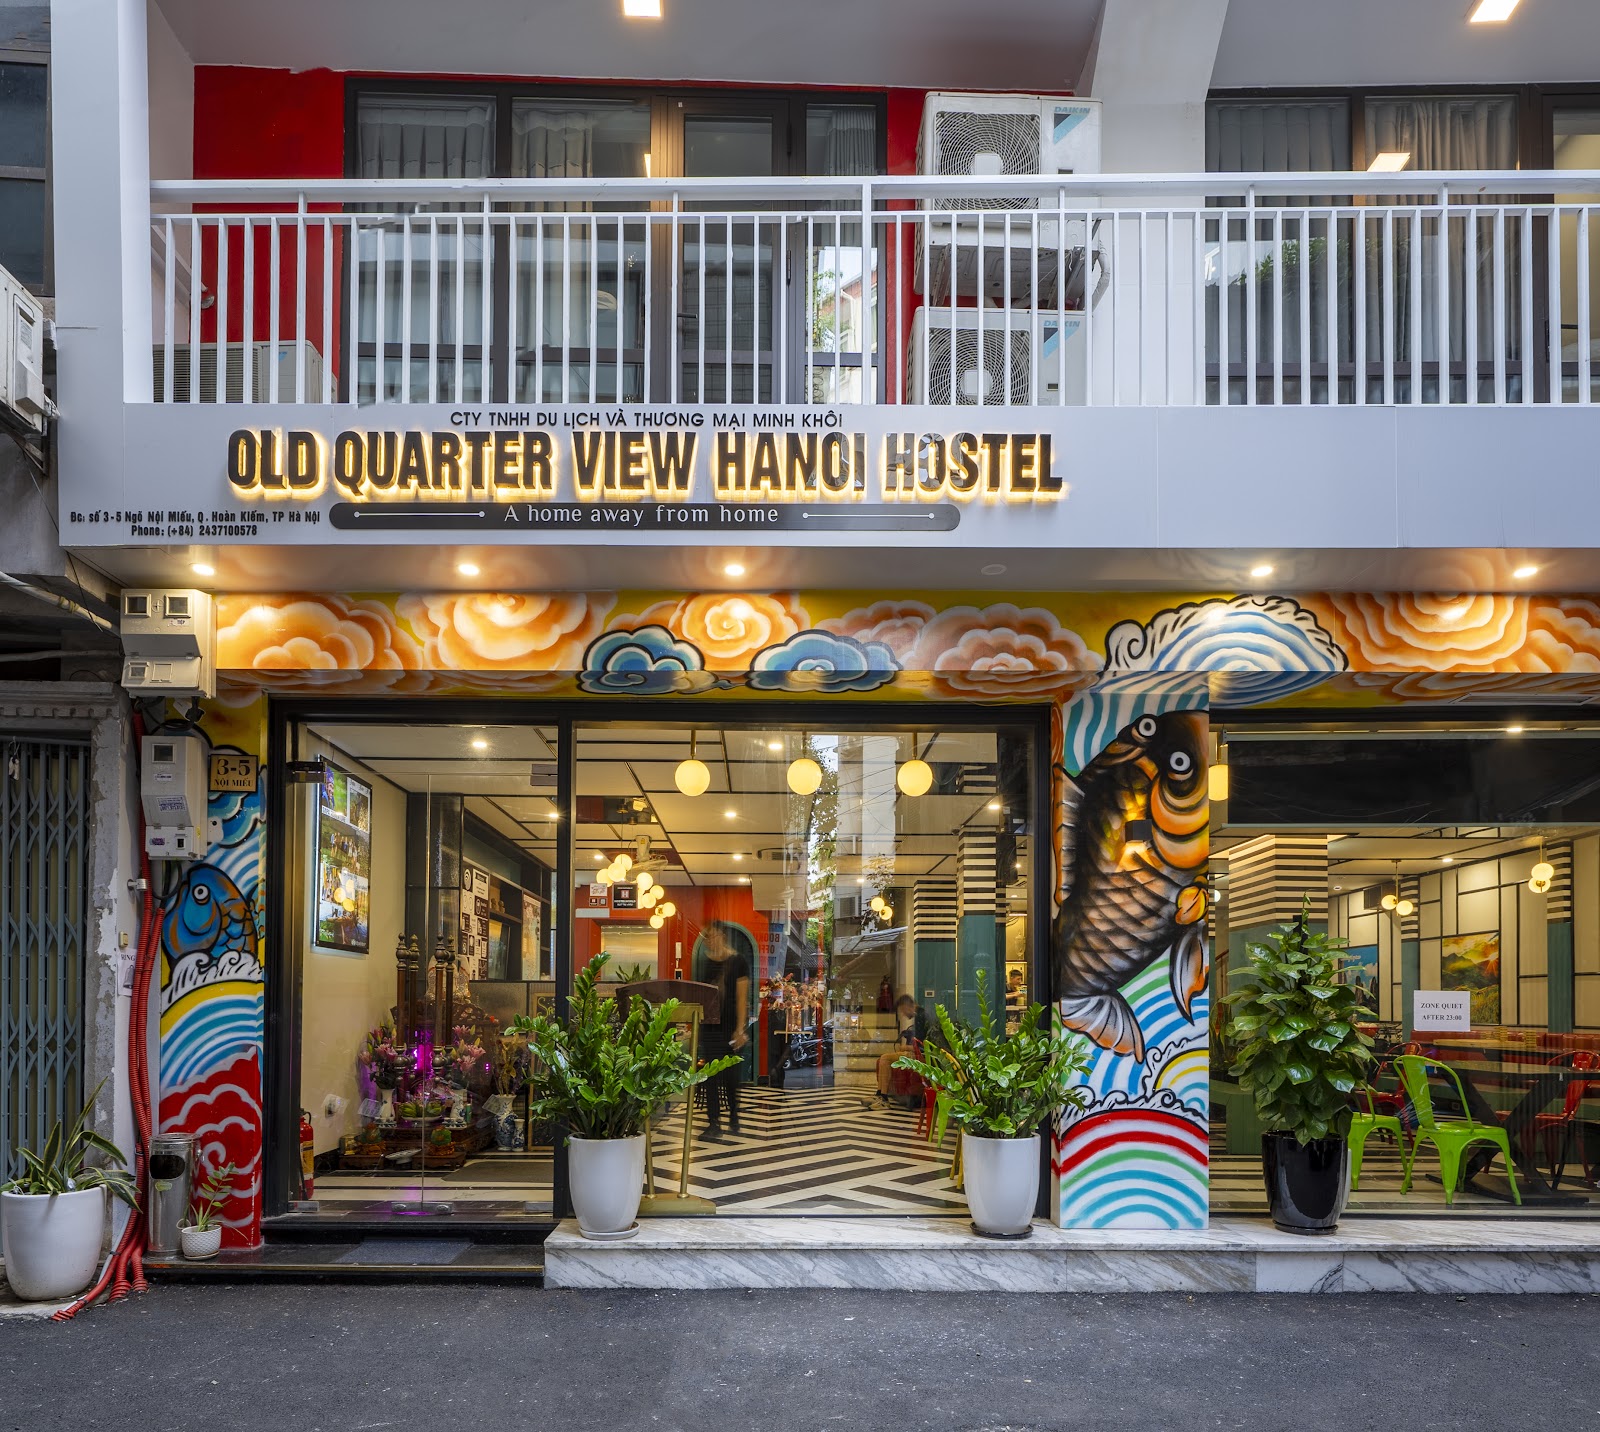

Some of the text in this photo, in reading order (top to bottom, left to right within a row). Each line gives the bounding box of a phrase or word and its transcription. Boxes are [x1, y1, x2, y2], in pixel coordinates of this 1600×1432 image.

[1054, 106, 1090, 114] DAIKIN
[1043, 320, 1080, 328] DAKIN
[450, 408, 843, 430] CTY TNHH DU LỊCH VÀ THƯƠNG MẠI MINH KHÔI
[227, 430, 1064, 496] OLD QUARTER VIEW HANOI HOSTEL
[88, 509, 102, 523] số
[124, 511, 143, 524] Ngõ
[147, 511, 164, 525] Nội
[211, 510, 236, 523] Hoàn
[272, 511, 285, 523] TP
[288, 510, 301, 523] Hà
[304, 511, 321, 525] Nội
[504, 505, 779, 527] A home away from home
[131, 524, 258, 538] Phone: (+84) 2437100578
[216, 758, 251, 777] 3-5
[213, 777, 230, 788] NỘI
[120, 953, 136, 962] RING
[1420, 1002, 1463, 1010] ZONE QUIET
